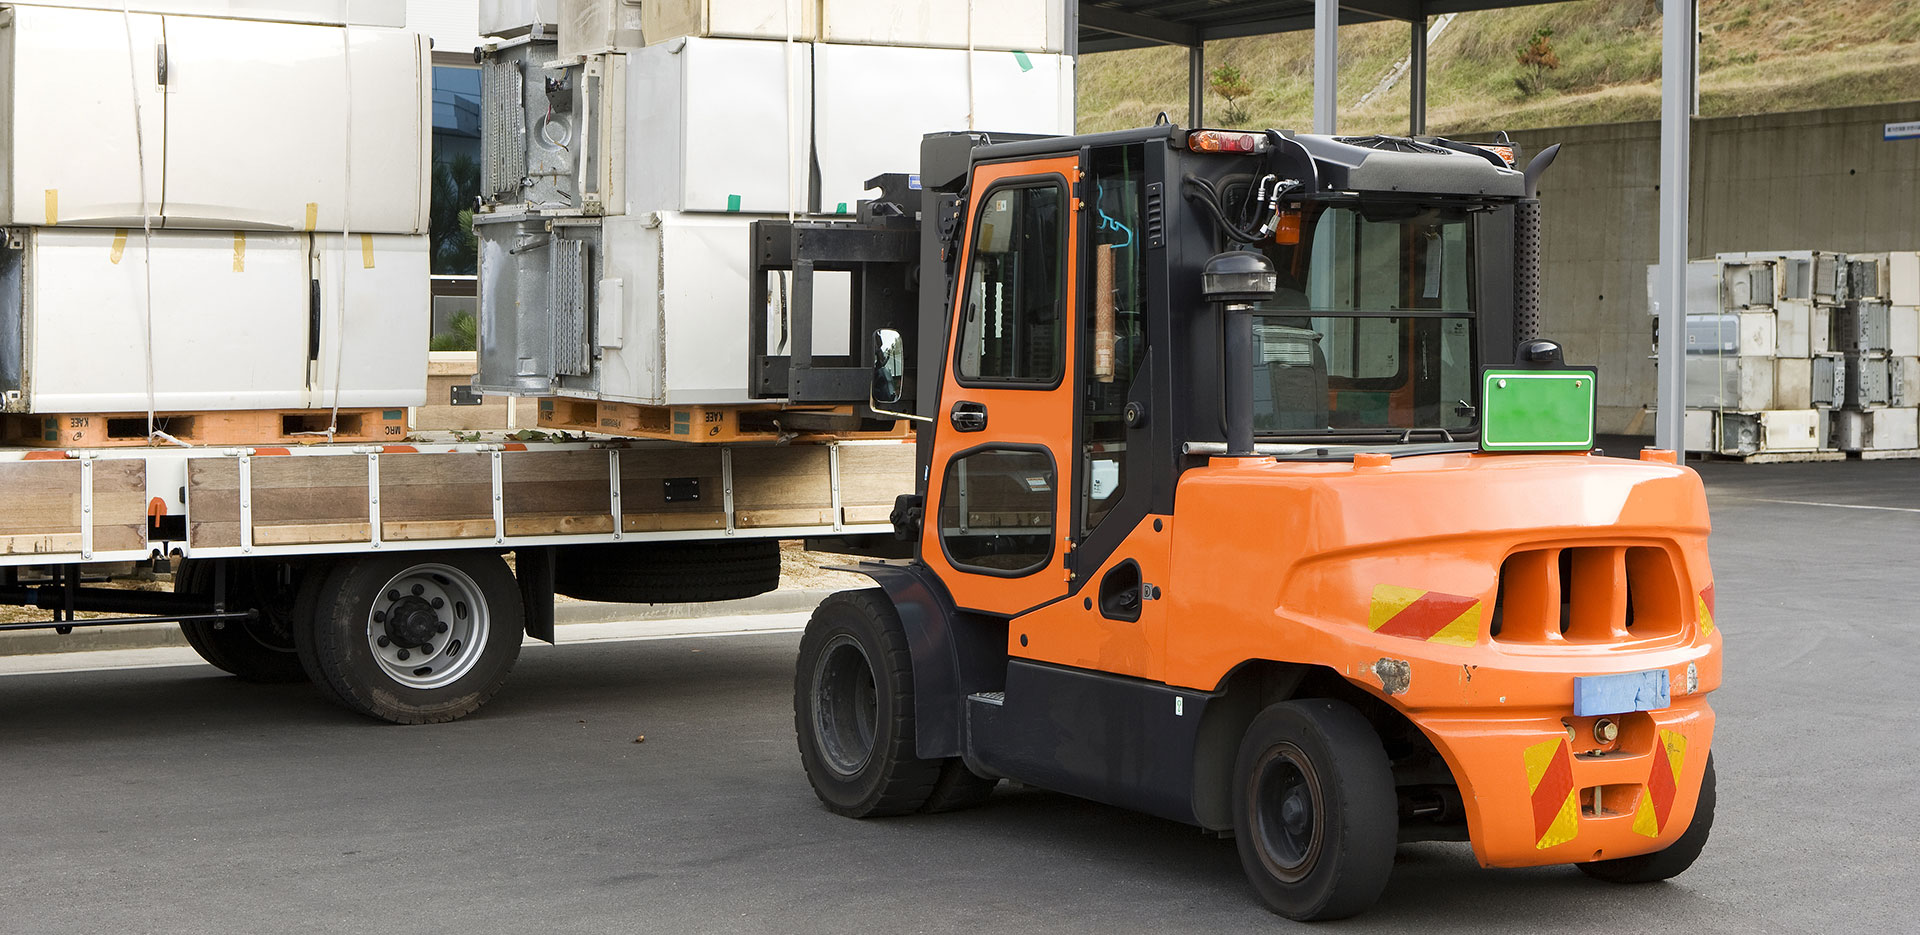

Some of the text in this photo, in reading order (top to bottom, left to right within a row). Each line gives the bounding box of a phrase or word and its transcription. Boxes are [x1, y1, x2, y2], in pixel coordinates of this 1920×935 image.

[705, 412, 723, 422] KAEE
[71, 417, 89, 428] KAEE
[385, 425, 401, 435] MRC
